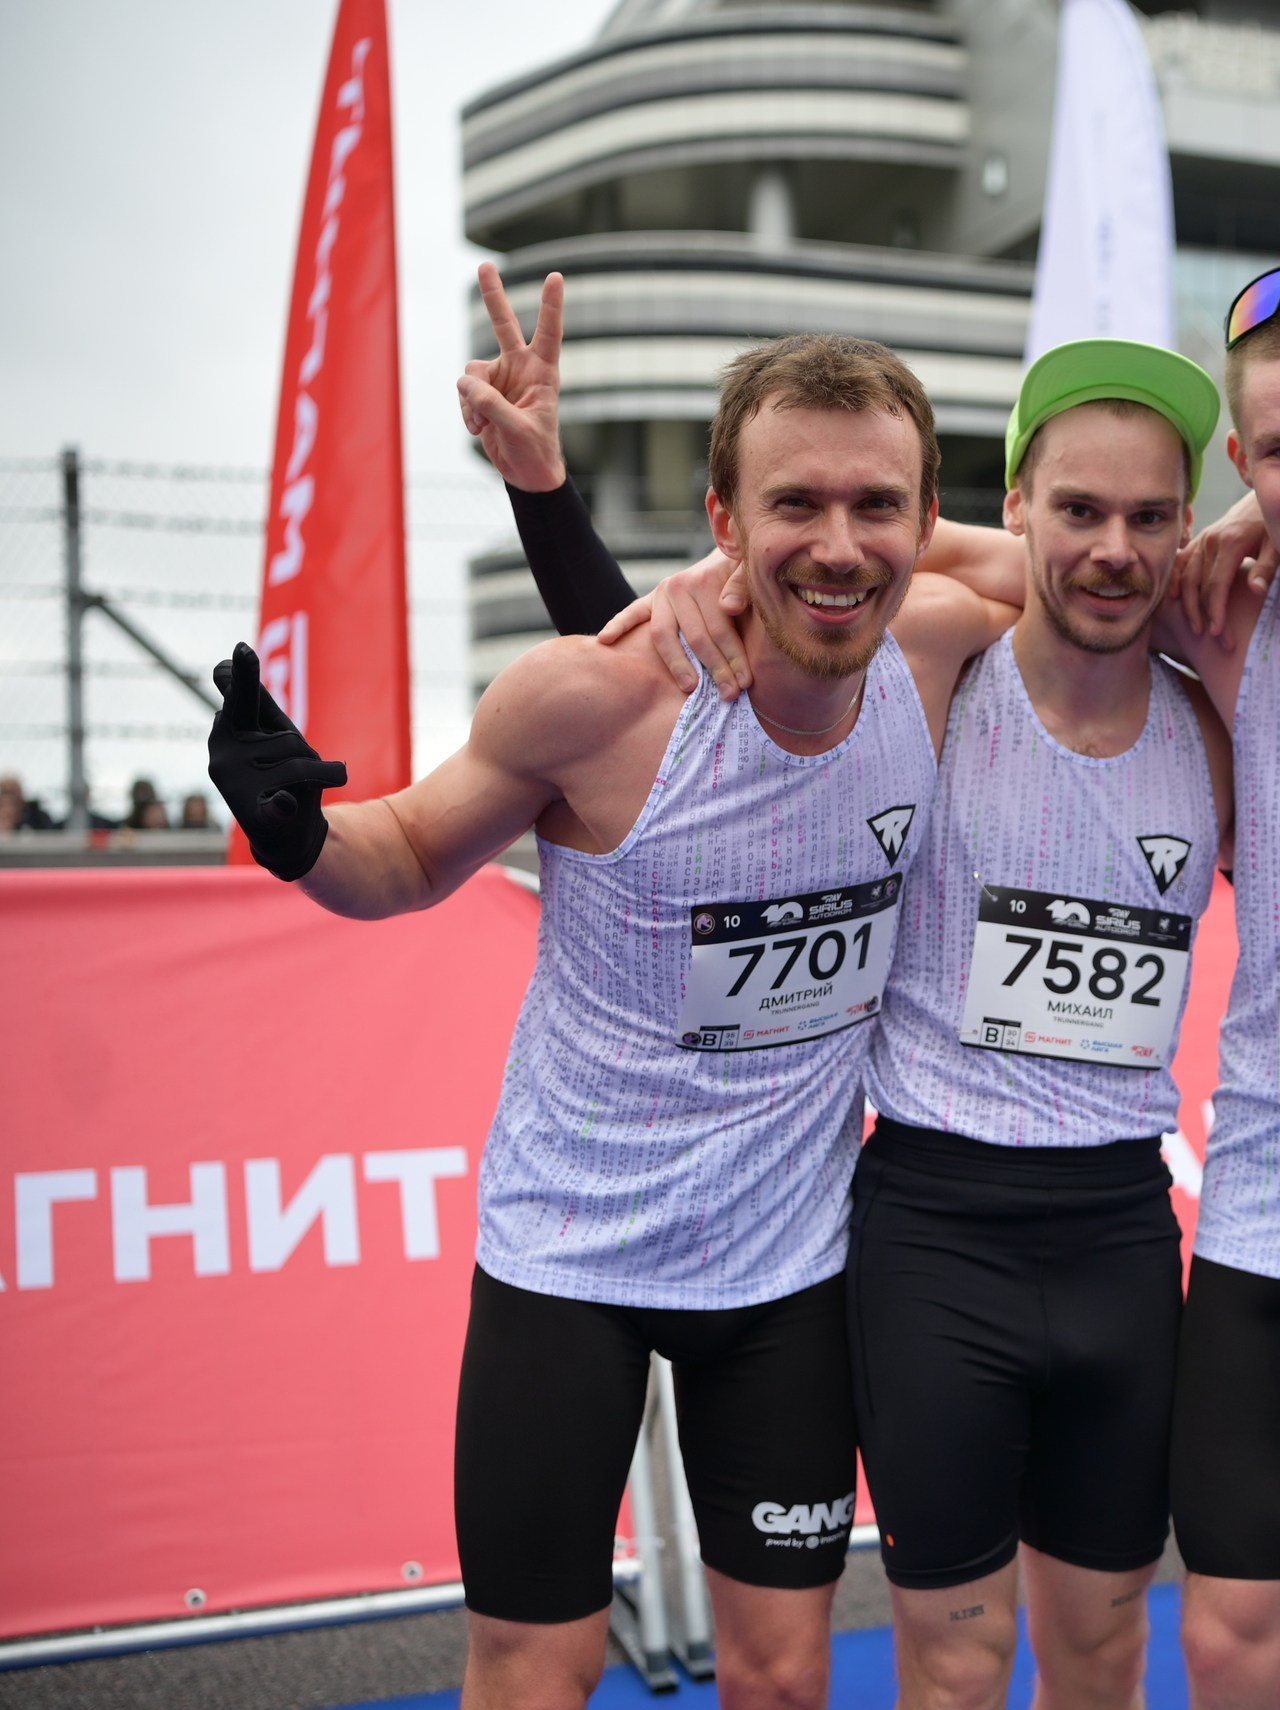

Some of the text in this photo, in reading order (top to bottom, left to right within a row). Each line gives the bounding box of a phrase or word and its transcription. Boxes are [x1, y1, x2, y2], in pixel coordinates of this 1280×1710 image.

[809, 899, 853, 915] SIRIUS
[1009, 899, 1027, 913] 10
[808, 908, 853, 920] AUTODROM
[723, 915, 741, 929] 10
[1095, 915, 1141, 930] SIRIUS
[726, 922, 873, 998] 7701
[1001, 933, 1165, 1007] 7582
[758, 981, 833, 1011] ДМИТРИЙ
[771, 1001, 820, 1016] TRUNNERGANG
[1047, 1000, 1113, 1020] МИХАИЛ
[756, 1026, 790, 1037] МАГНИТ
[985, 1027, 999, 1043] B
[702, 1033, 717, 1046] B
[1038, 1035, 1072, 1047] МАГНИТ
[0, 1145, 469, 1292] ГНИТ
